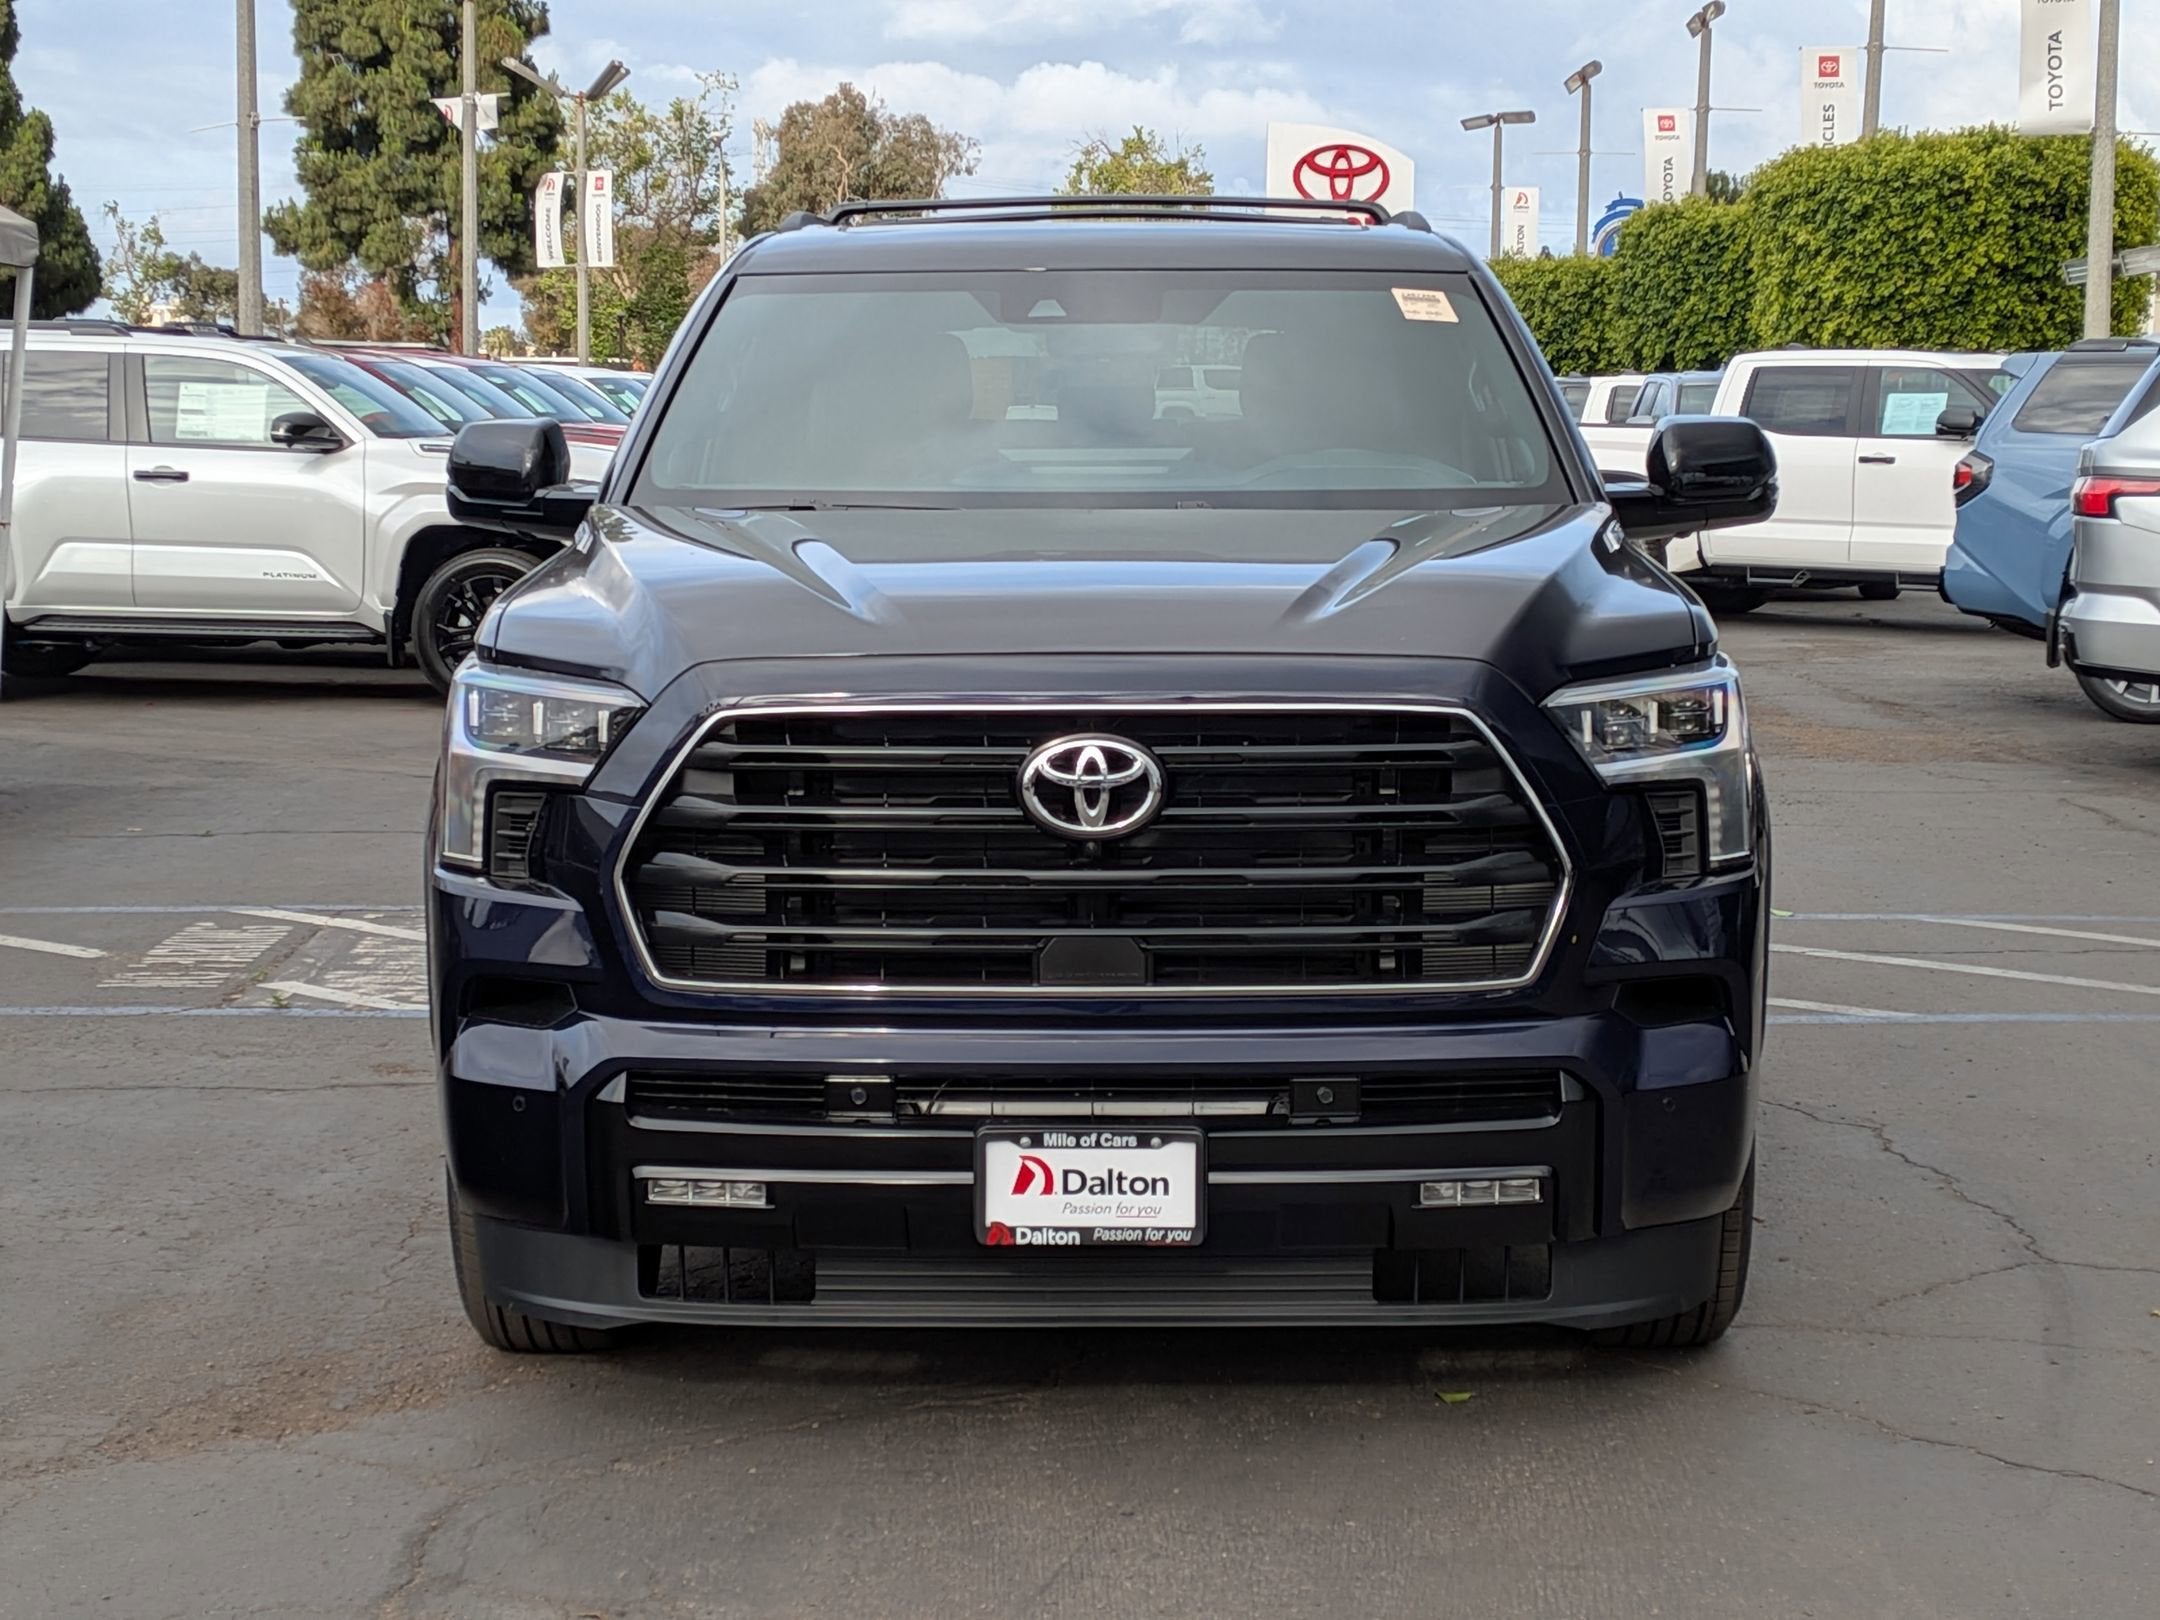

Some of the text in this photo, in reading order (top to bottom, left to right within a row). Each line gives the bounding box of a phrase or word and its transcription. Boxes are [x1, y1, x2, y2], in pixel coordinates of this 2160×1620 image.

[2048, 30, 2063, 111] TOYOTA
[1823, 104, 1835, 148] ICLES
[1663, 157, 1674, 202] OYOTA
[545, 208, 554, 260] WELCOME
[262, 571, 317, 579] PLATINUM
[1043, 1133, 1137, 1147] Mile of Cars
[1062, 1168, 1169, 1196] Dalton
[1061, 1202, 1162, 1217] Passion for you
[1015, 1227, 1192, 1245] Dalton Passion for you
